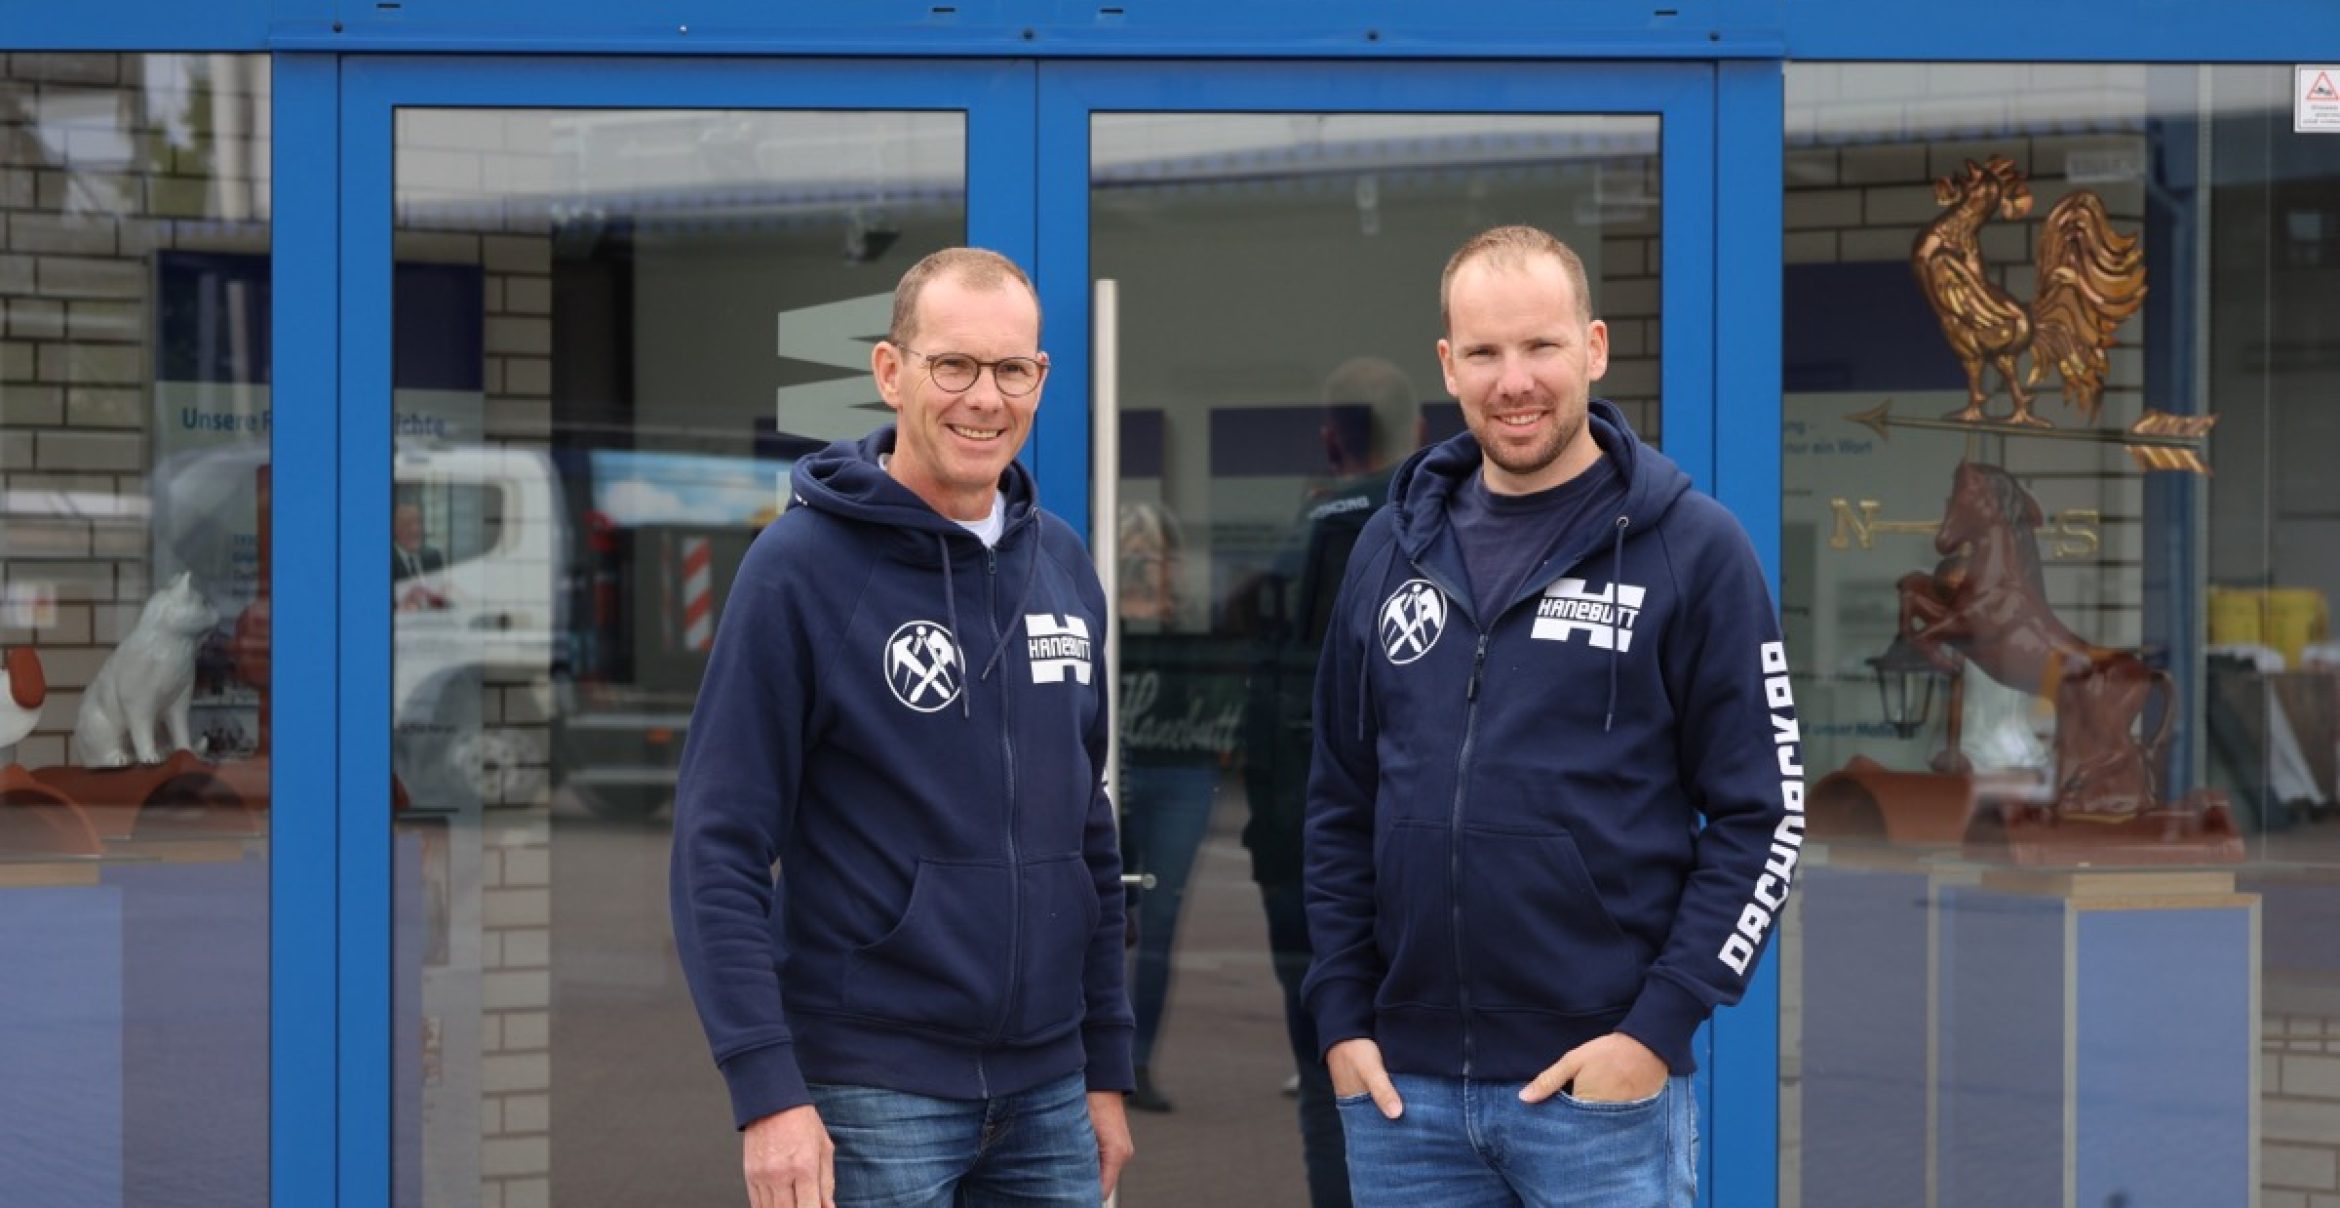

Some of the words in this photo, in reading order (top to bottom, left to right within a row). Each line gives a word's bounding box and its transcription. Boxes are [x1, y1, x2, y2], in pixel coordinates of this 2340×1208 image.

[182, 407, 257, 431] Unsere
[1829, 498, 1879, 550] N
[2056, 508, 2099, 558] S
